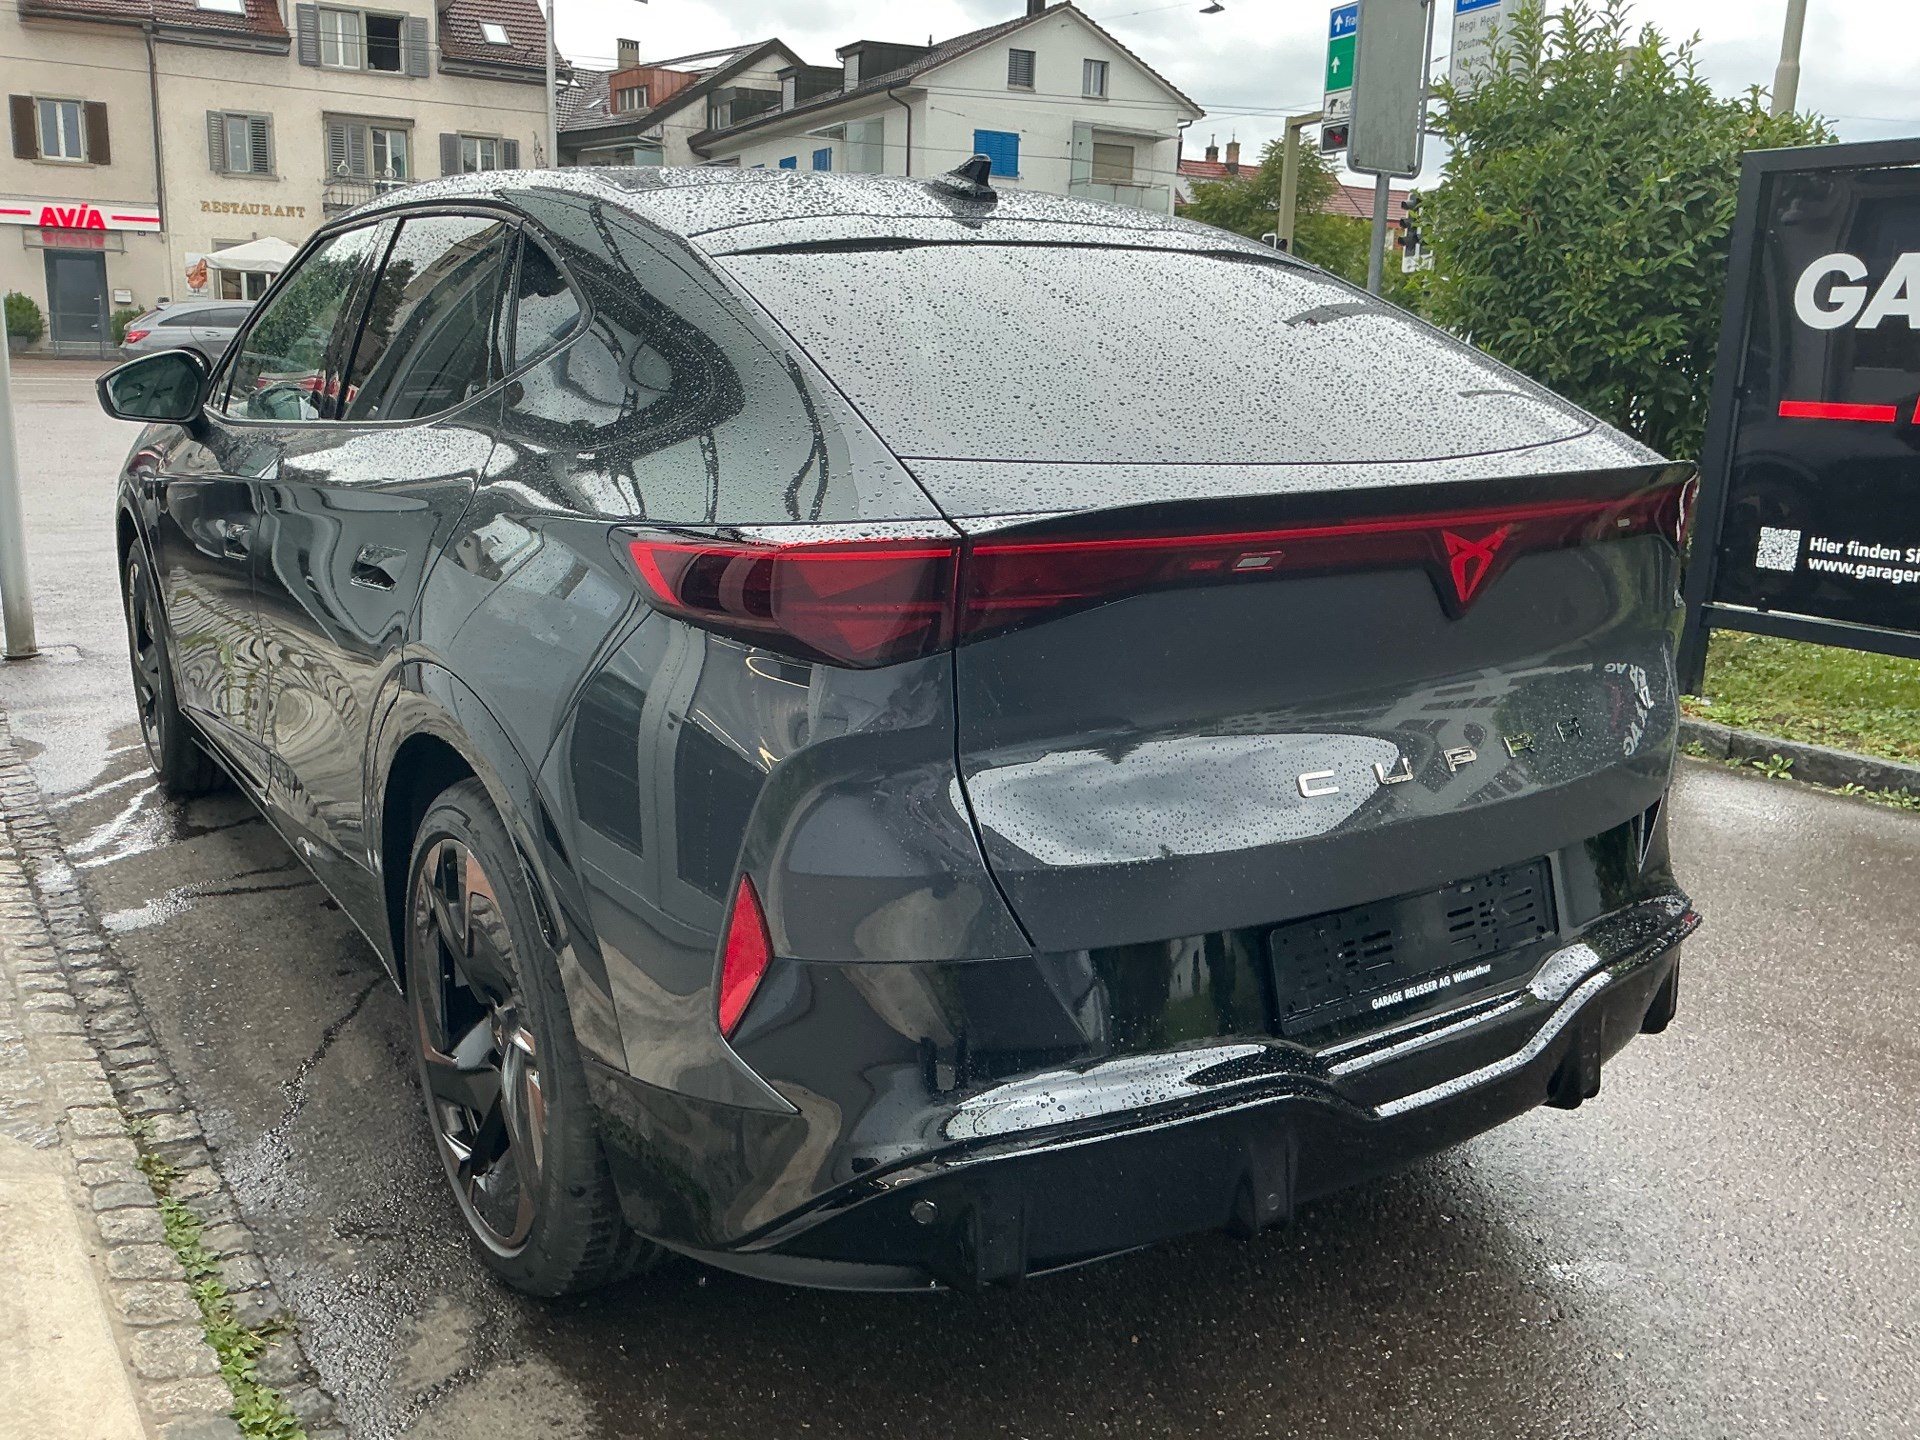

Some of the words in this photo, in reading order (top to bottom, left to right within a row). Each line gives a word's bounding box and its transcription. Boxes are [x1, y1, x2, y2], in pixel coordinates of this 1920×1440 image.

[201, 200, 306, 218] RESTAURANT
[1809, 536, 1844, 554] Hier
[1847, 540, 1901, 562] finden
[1371, 990, 1403, 1010] GARAGE
[1404, 979, 1438, 1000] REUSSER
[1438, 975, 1451, 989] AG
[1452, 963, 1491, 984] Winterthur
